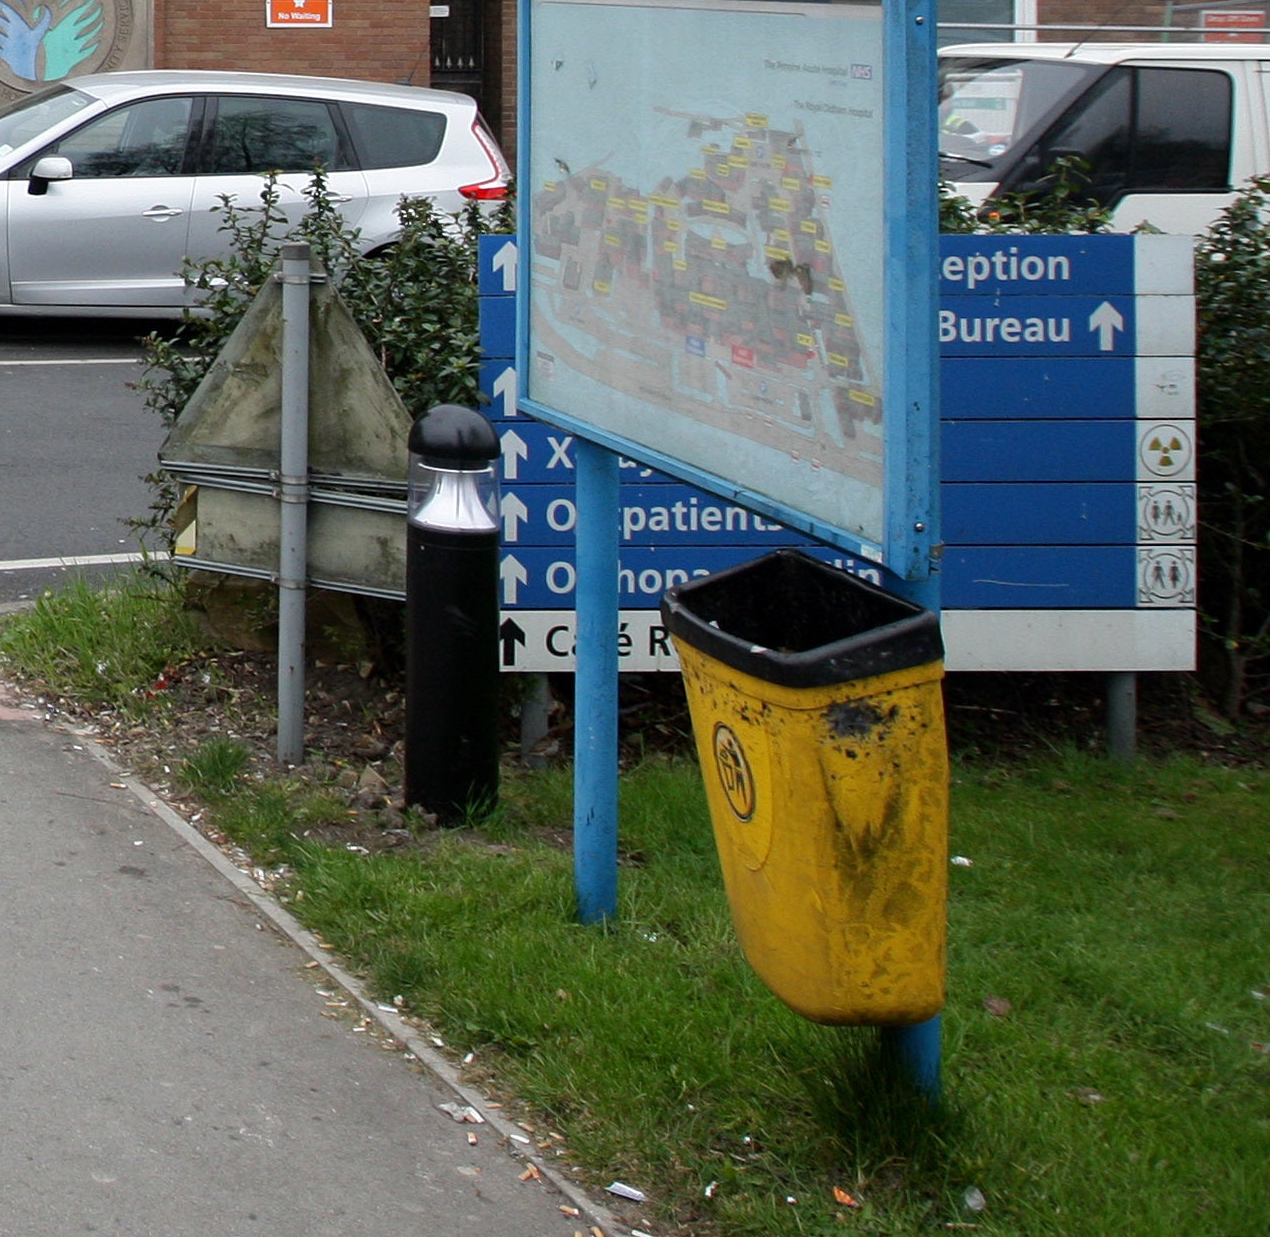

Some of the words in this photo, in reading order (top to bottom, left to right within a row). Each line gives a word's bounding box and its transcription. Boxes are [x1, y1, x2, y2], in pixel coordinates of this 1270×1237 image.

[291, 12, 320, 21] Waiting
[939, 246, 1071, 290] eption
[939, 310, 1071, 342] Bureau
